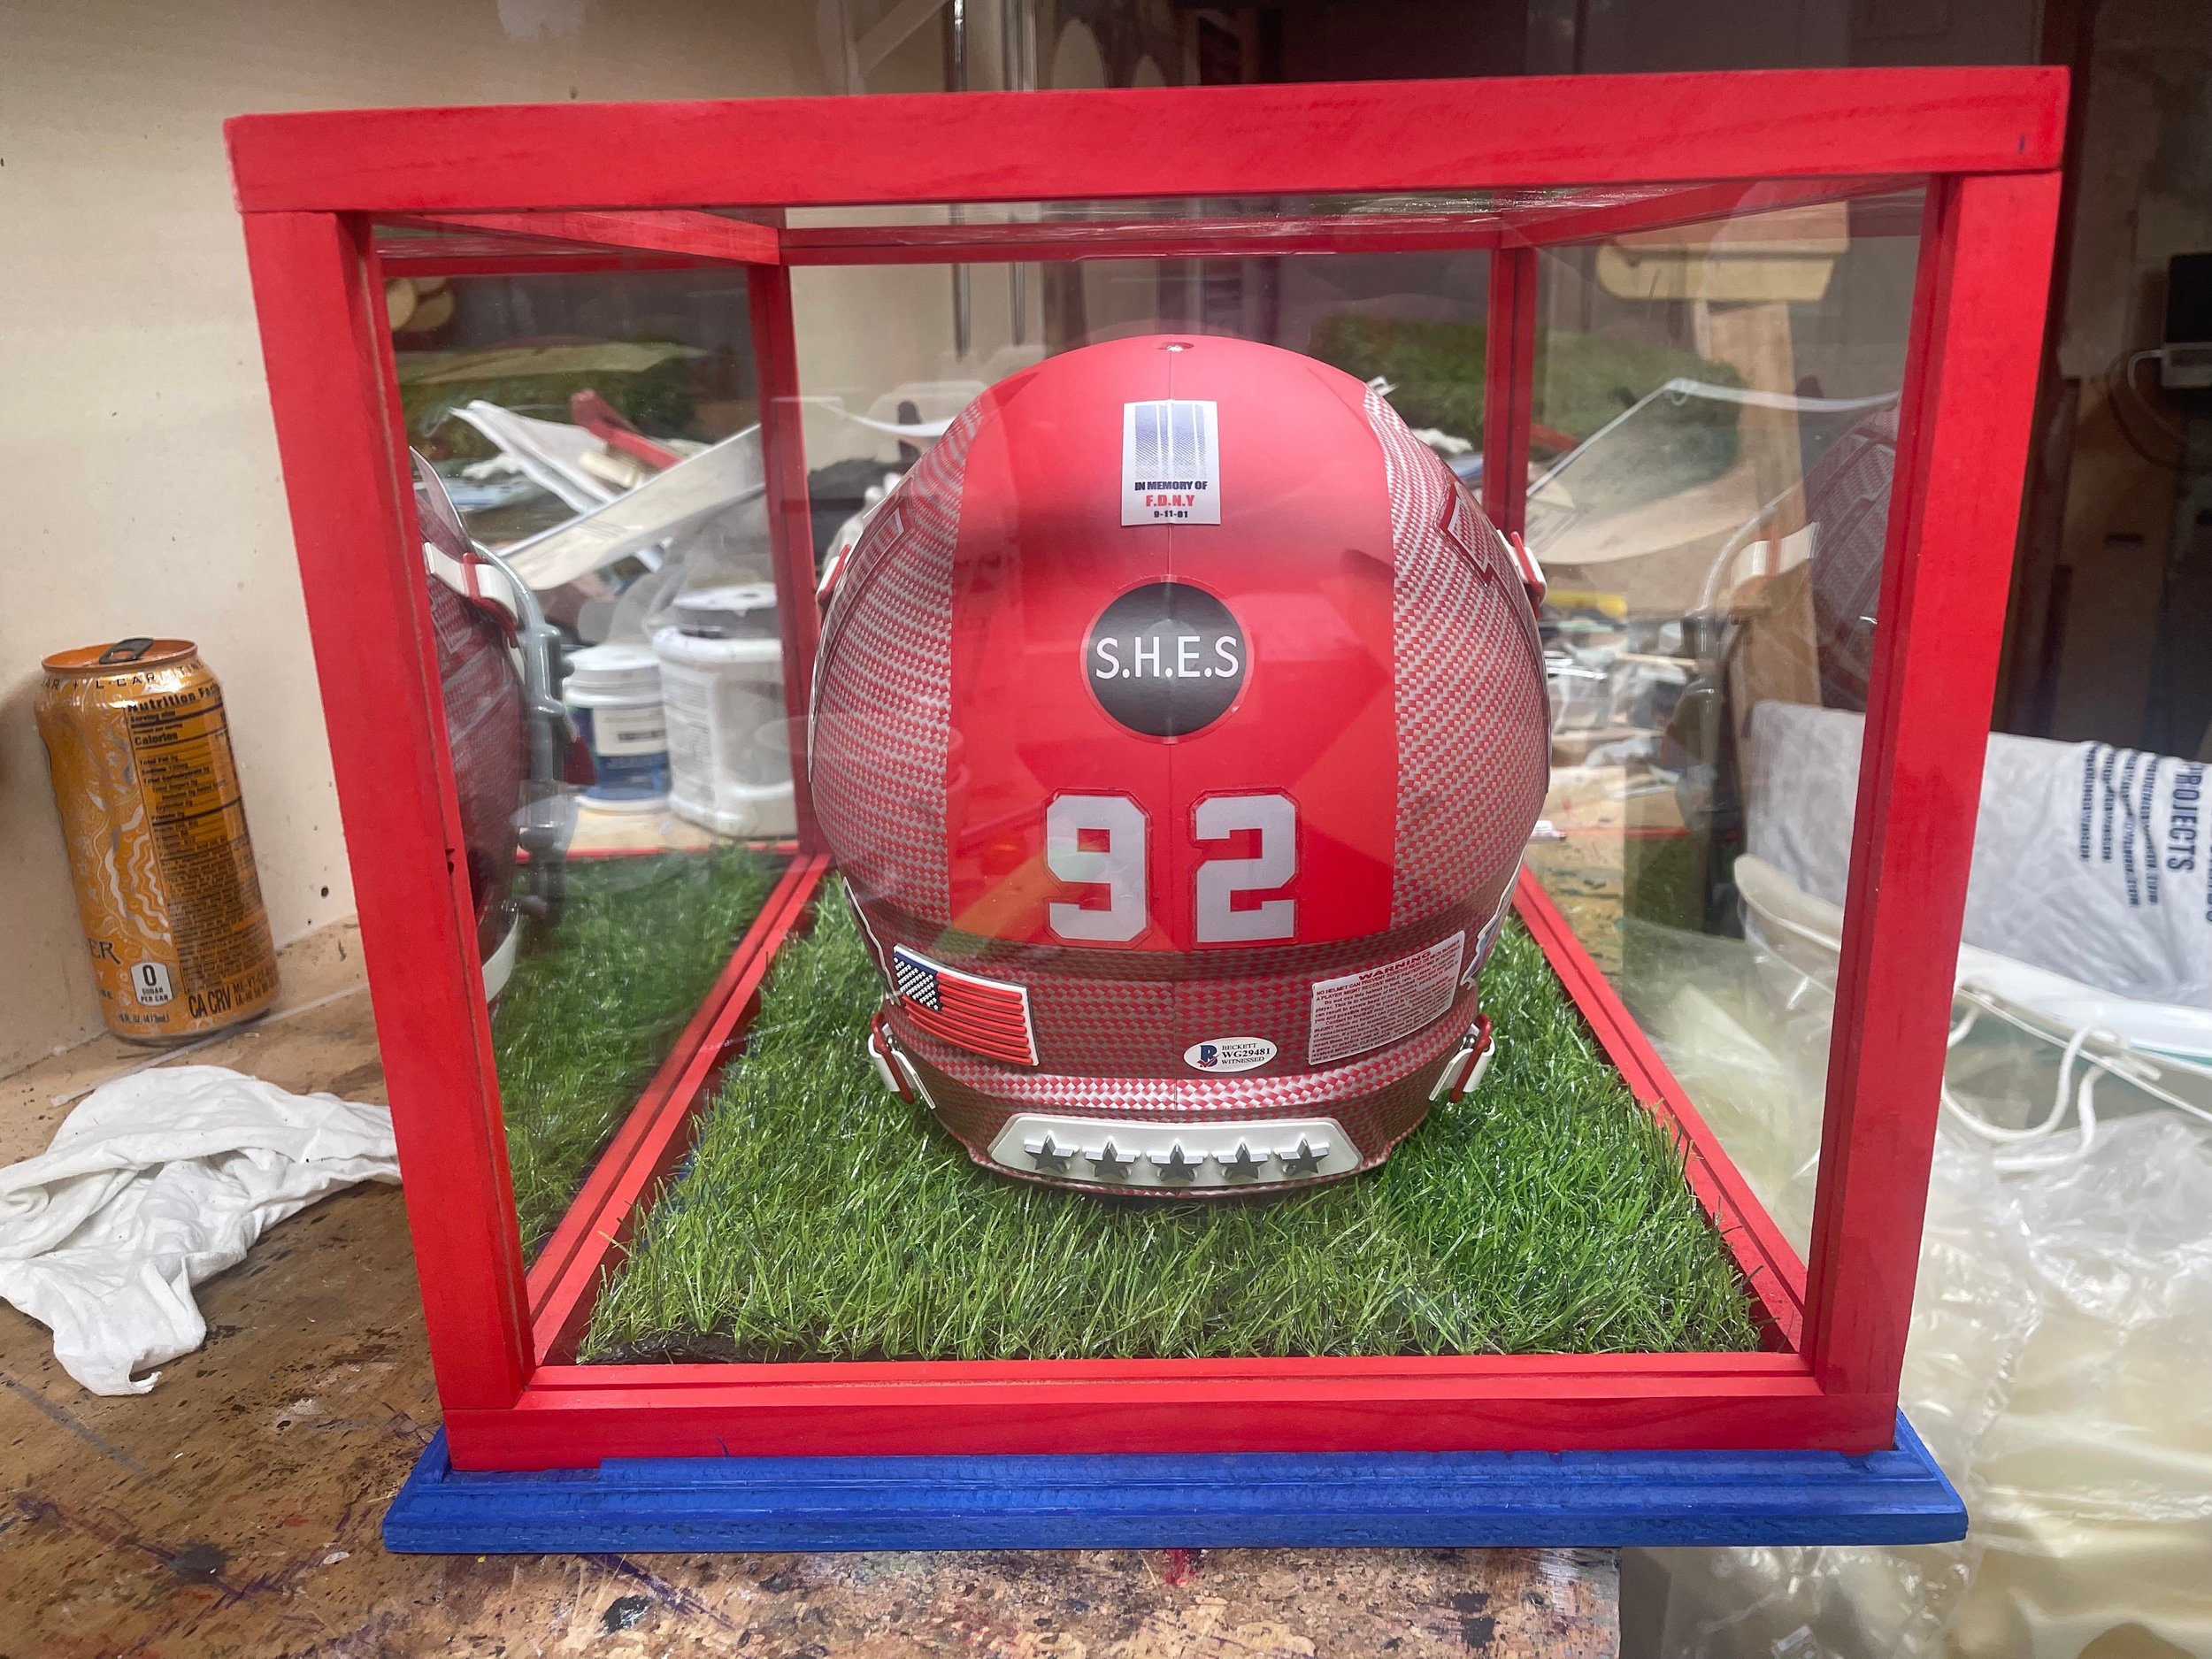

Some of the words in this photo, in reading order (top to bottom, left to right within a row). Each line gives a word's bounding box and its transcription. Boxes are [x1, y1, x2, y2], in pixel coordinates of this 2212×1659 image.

[1135, 481, 1145, 490] IN
[1147, 480, 1193, 490] MEMORY
[1194, 480, 1208, 490] OF
[1146, 495, 1195, 507] F.D.N.Y
[1154, 510, 1188, 518] 9-11-01
[1094, 635, 1239, 679] S.H.E.S
[127, 692, 196, 712] Nutrition
[134, 732, 178, 746] Calories
[1359, 951, 1431, 981] WARNING
[142, 964, 157, 987] 0
[188, 993, 208, 1019] CA
[207, 986, 232, 1015] CRV
[1222, 1048, 1271, 1058] WG29481
[1221, 1056, 1265, 1065] WITNESSED
